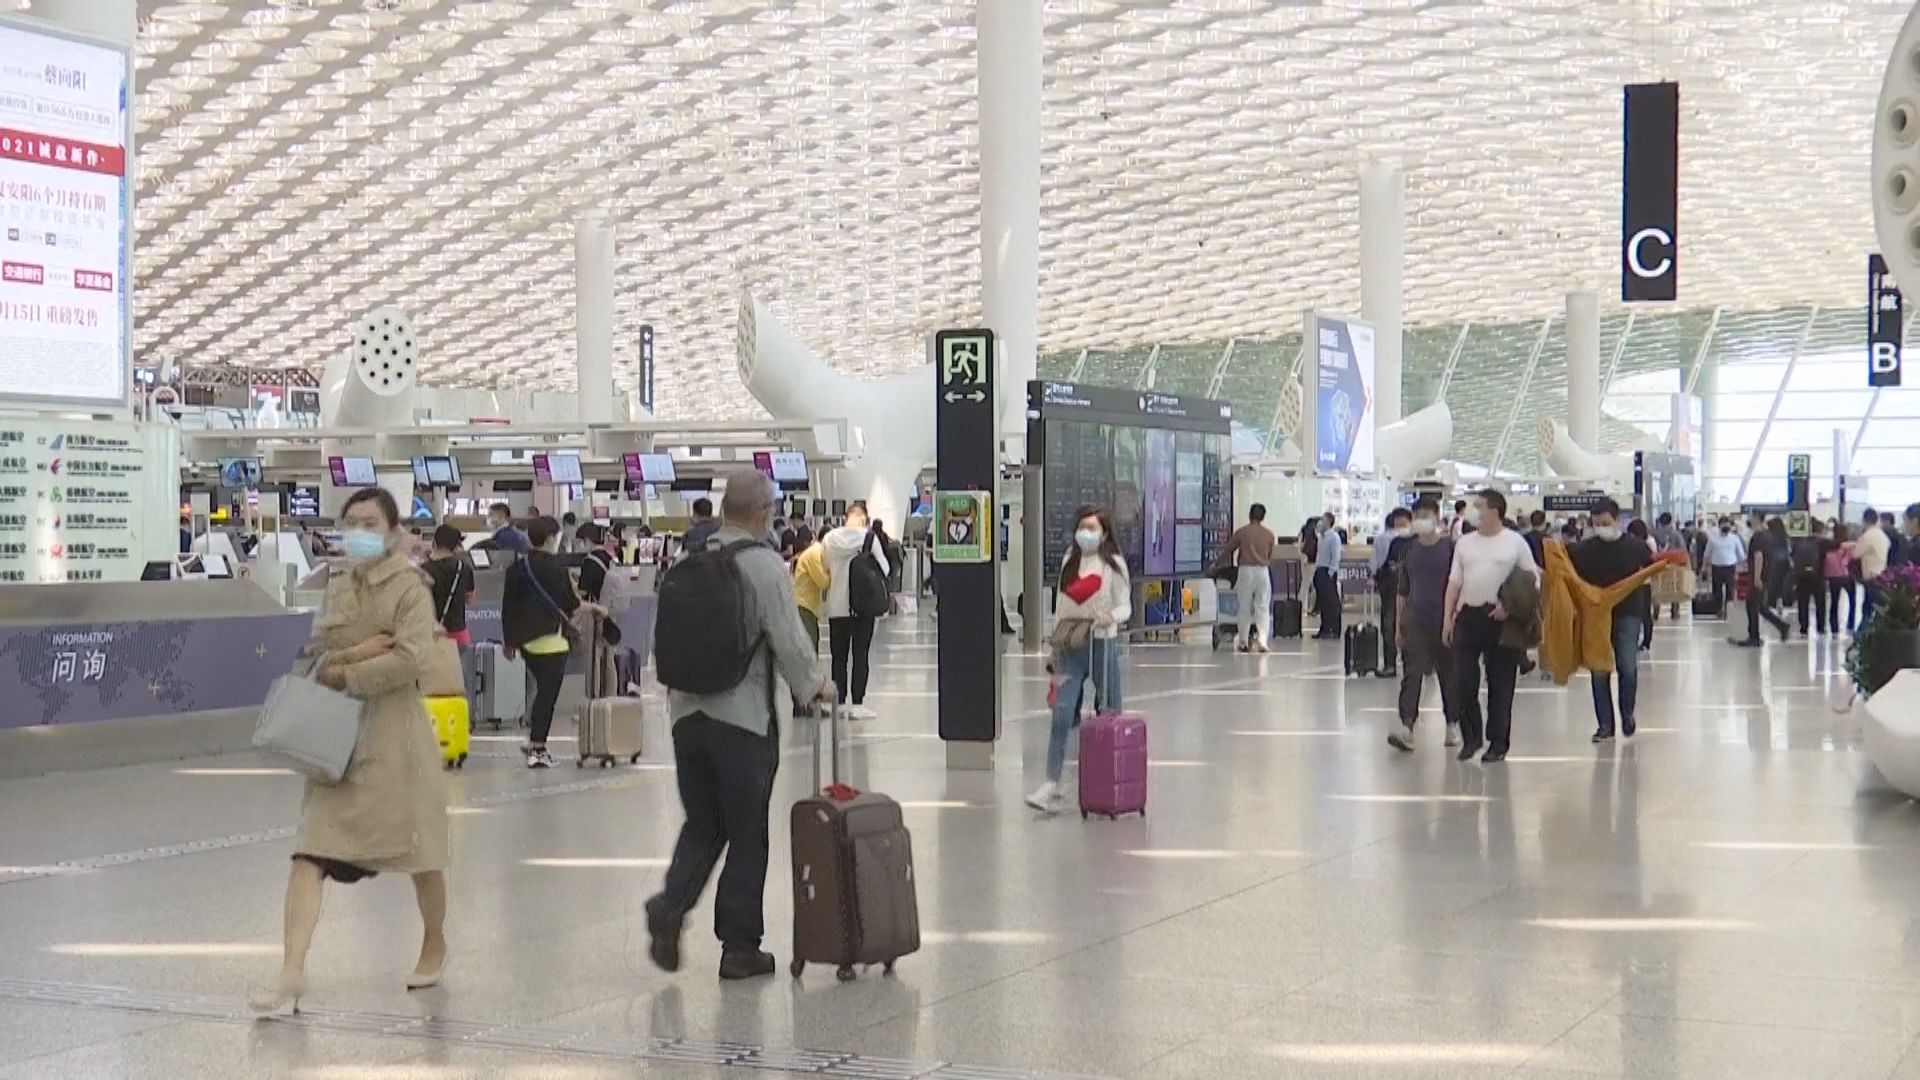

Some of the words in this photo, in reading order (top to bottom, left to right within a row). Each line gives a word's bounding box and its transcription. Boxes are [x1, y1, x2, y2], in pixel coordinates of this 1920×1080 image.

[1628, 227, 1671, 278] C
[1872, 342, 1898, 373] B
[52, 631, 114, 646] INFORMATION
[51, 648, 107, 684] 问询
